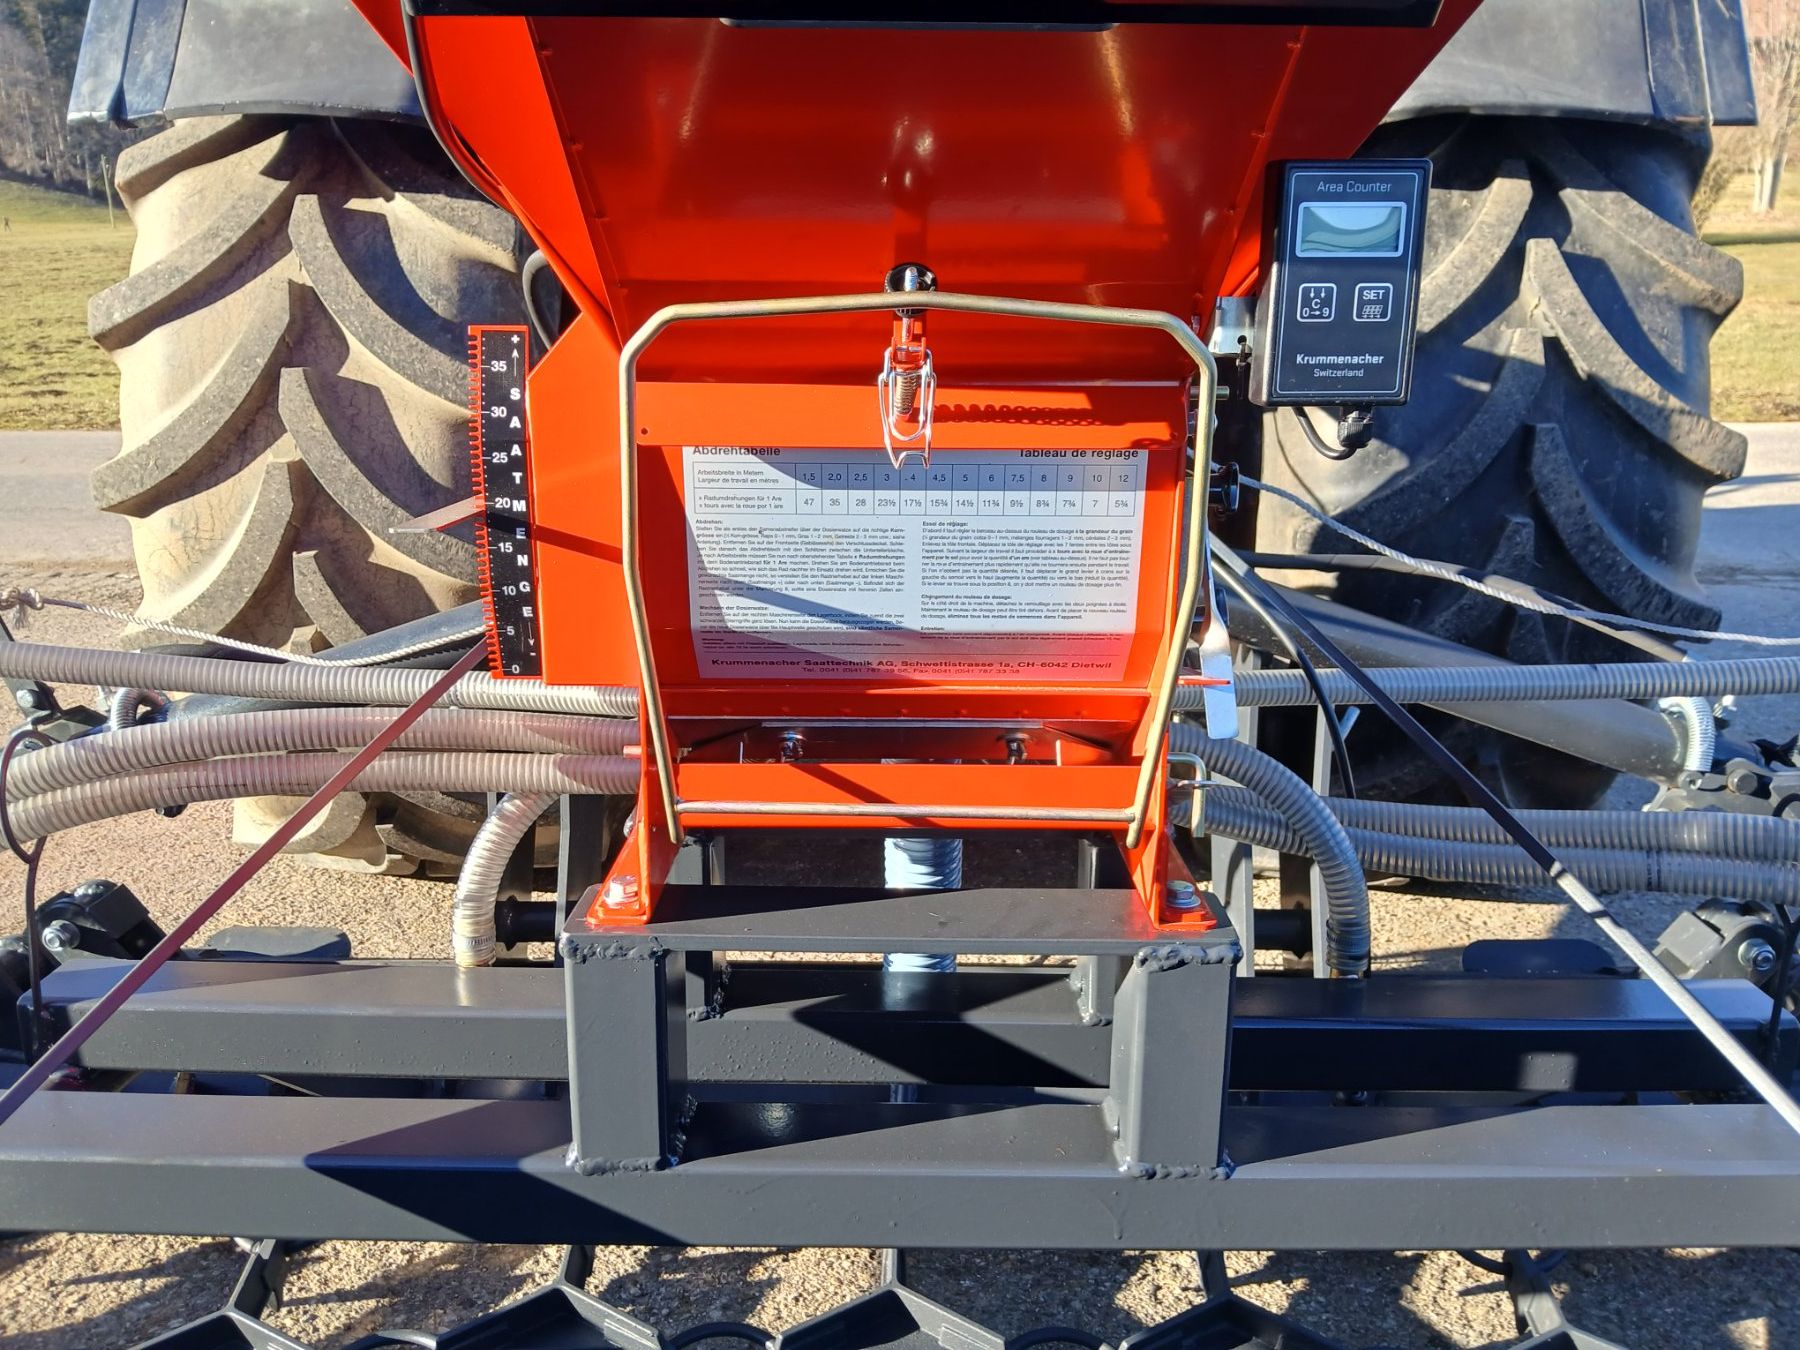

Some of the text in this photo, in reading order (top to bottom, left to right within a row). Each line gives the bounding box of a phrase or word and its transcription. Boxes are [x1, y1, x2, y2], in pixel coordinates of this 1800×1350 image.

[1316, 181, 1392, 193] Area Counter
[1362, 290, 1384, 300] SET
[1311, 299, 1320, 309] C
[1296, 354, 1384, 365] Krummenacher
[490, 360, 507, 372] 35
[1313, 368, 1364, 378] Switzerland
[490, 406, 507, 418] 30
[492, 452, 508, 464] 25
[1072, 450, 1086, 458] de
[494, 498, 511, 508] 20
[498, 542, 513, 552] 15
[502, 586, 516, 596] 10
[506, 626, 514, 636] 5
[512, 664, 520, 674] 0
